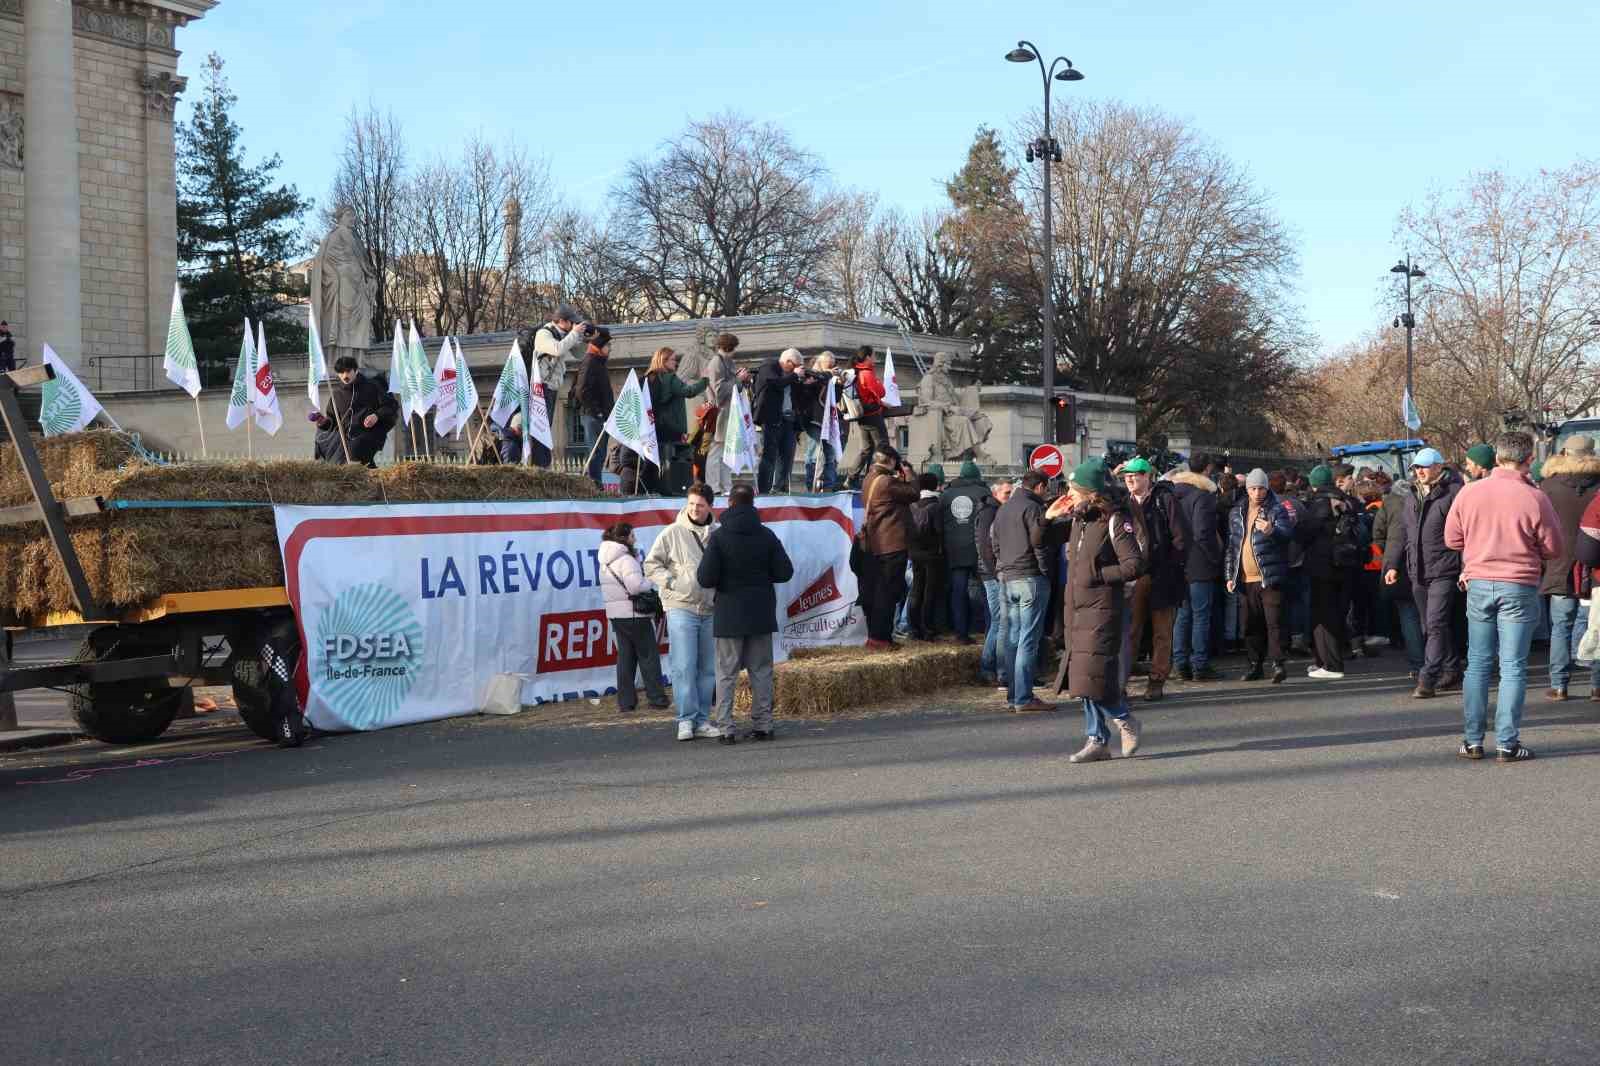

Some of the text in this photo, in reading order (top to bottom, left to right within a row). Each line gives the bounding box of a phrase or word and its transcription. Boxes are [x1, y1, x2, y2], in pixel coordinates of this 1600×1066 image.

[421, 557, 467, 599] LA
[479, 540, 600, 595] RÉVOLT
[323, 631, 411, 661] FDSEA
